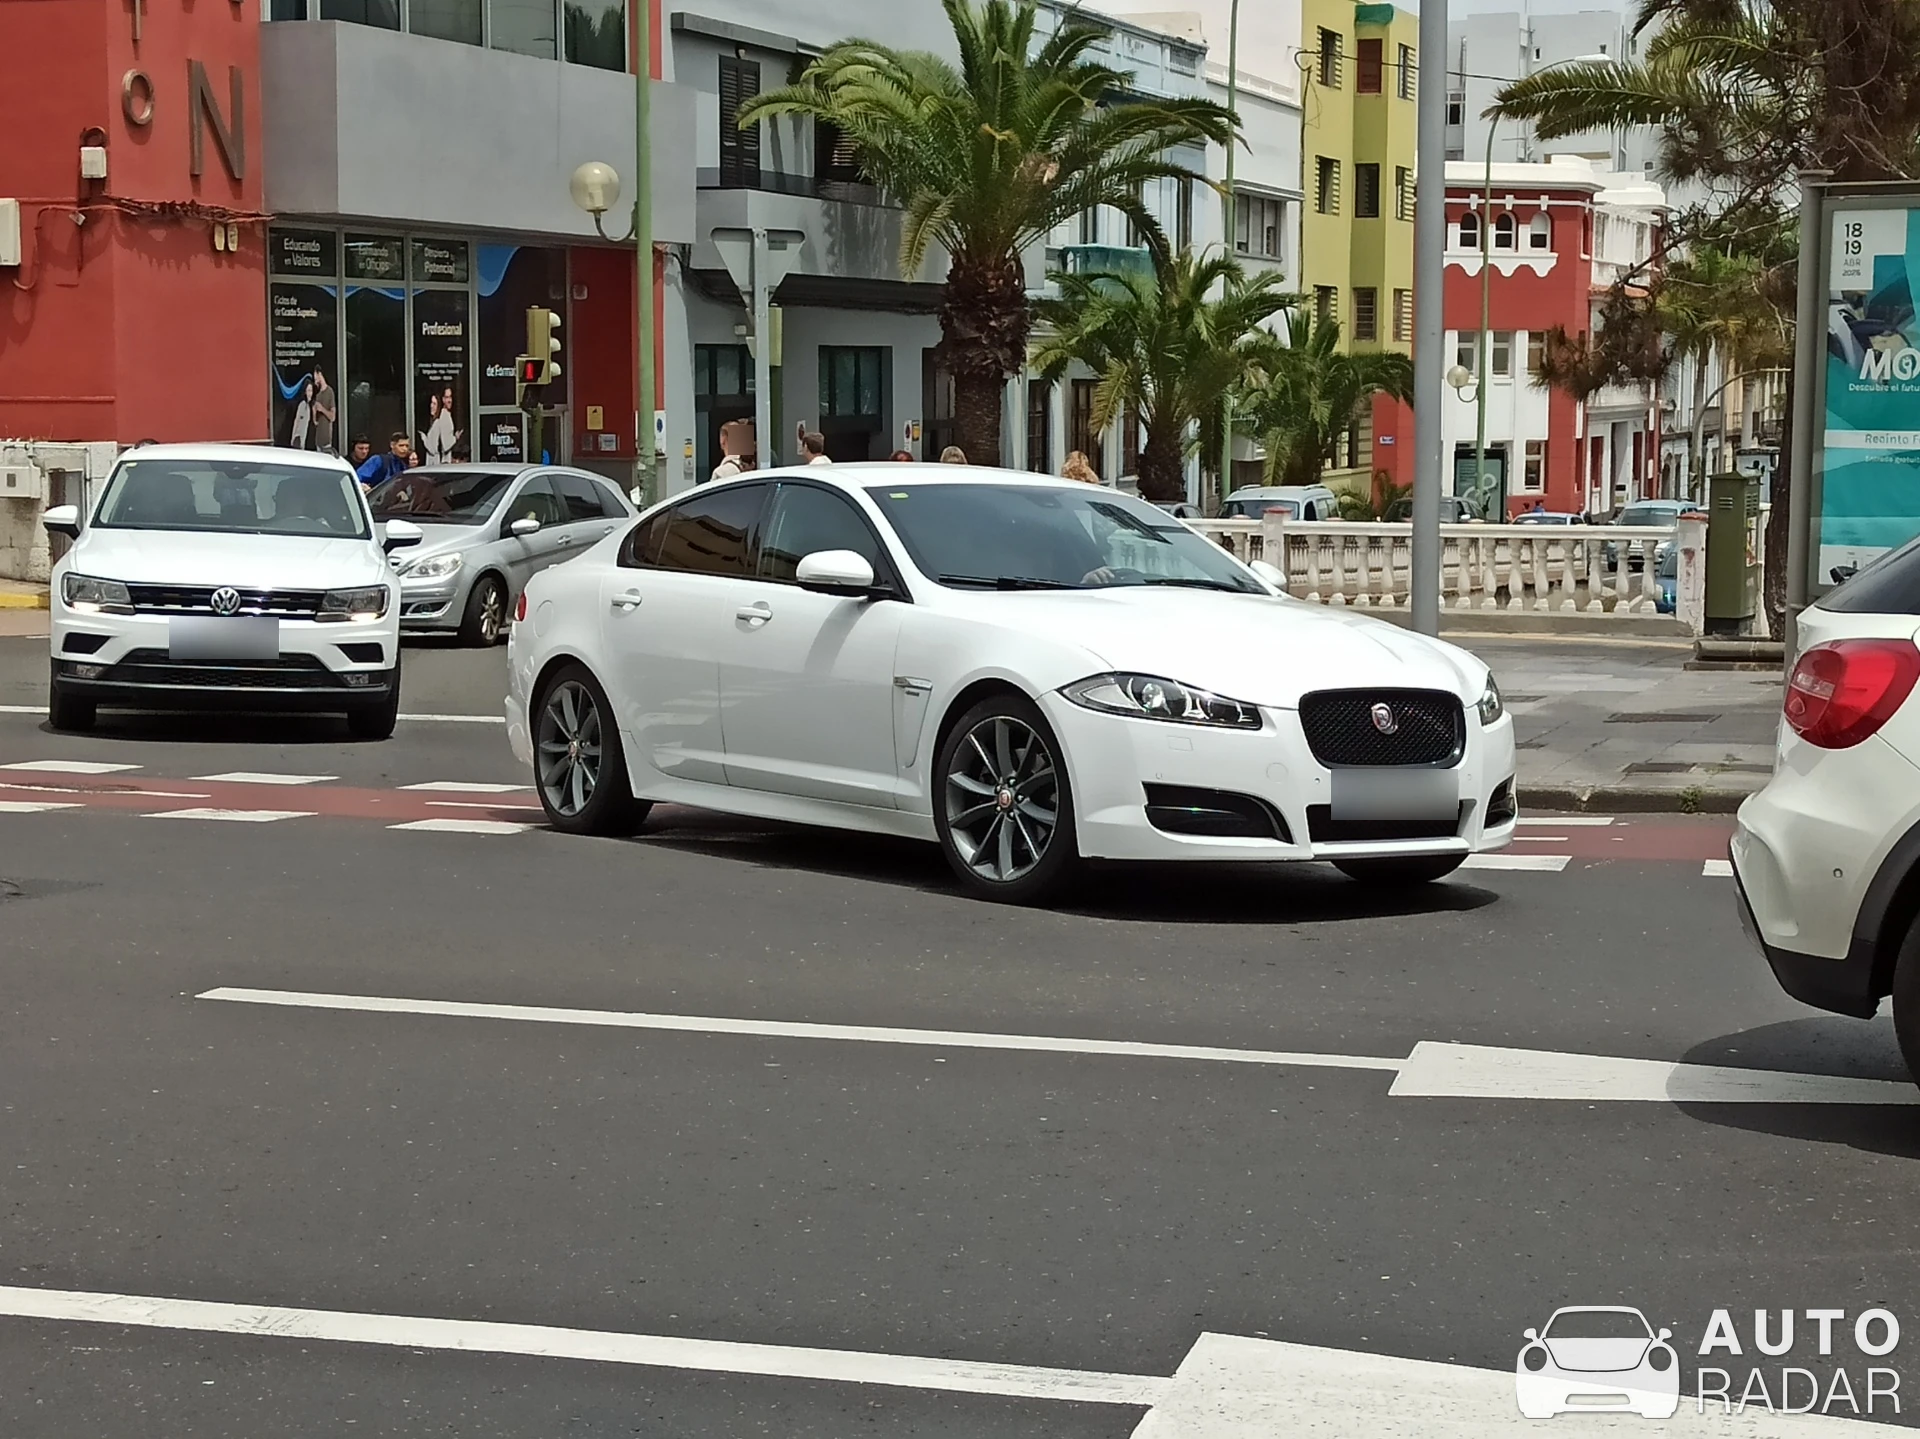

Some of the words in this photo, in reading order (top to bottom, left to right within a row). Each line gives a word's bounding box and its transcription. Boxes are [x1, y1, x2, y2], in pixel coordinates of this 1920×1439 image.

[1845, 222, 1863, 238] 18
[284, 238, 321, 252] Educando
[1845, 240, 1862, 255] 19
[292, 252, 321, 267] Valores
[366, 258, 391, 271] Oficios
[1843, 258, 1862, 267] ABR
[424, 261, 455, 274] Potencial
[422, 321, 463, 336] Profesional
[486, 364, 495, 377] de
[494, 364, 516, 377] Forma
[1848, 383, 1890, 392] Descubre
[1891, 383, 1899, 392] el
[489, 432, 511, 446] Marca
[1865, 433, 1909, 445] Recinto
[1913, 434, 1920, 445] F
